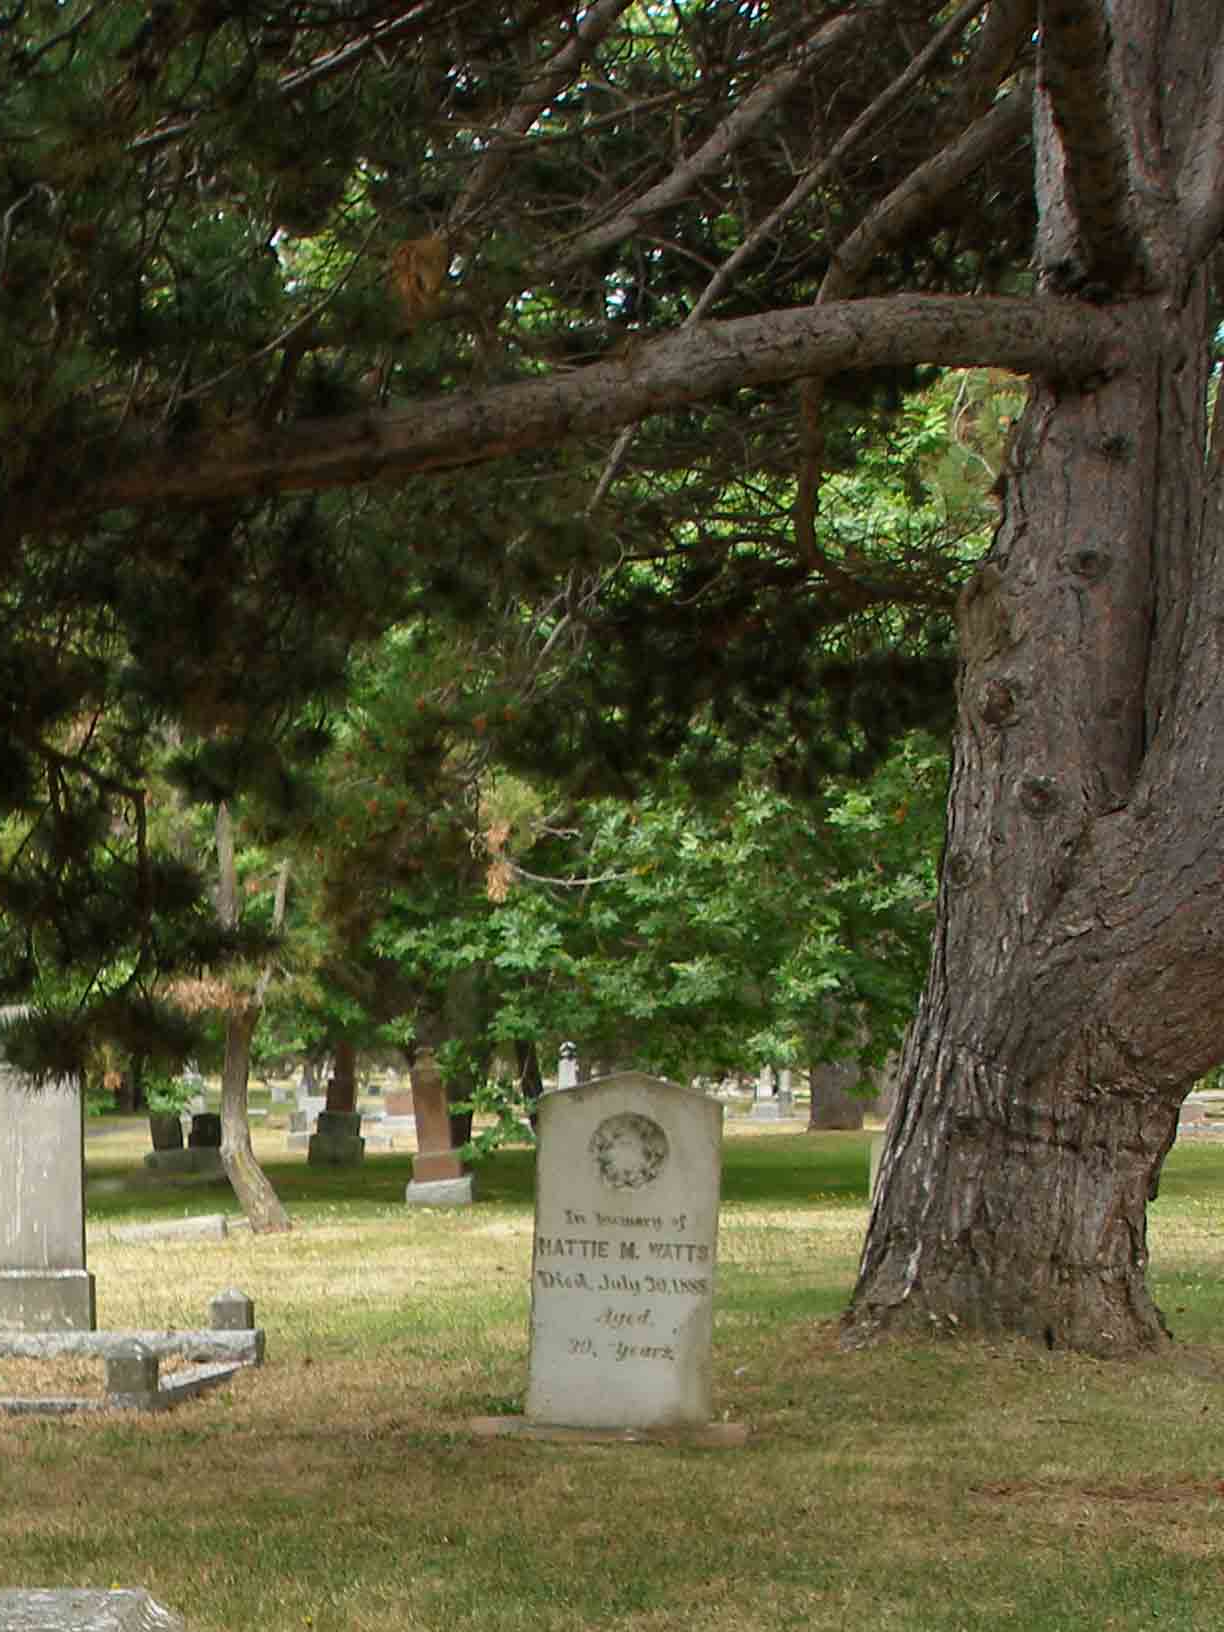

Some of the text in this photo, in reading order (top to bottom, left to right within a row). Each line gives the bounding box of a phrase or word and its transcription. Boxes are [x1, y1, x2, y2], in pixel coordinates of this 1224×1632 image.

[564, 1208, 587, 1227] In
[671, 1213, 688, 1232] of
[648, 1241, 710, 1264] WATTS
[598, 1273, 642, 1297] July
